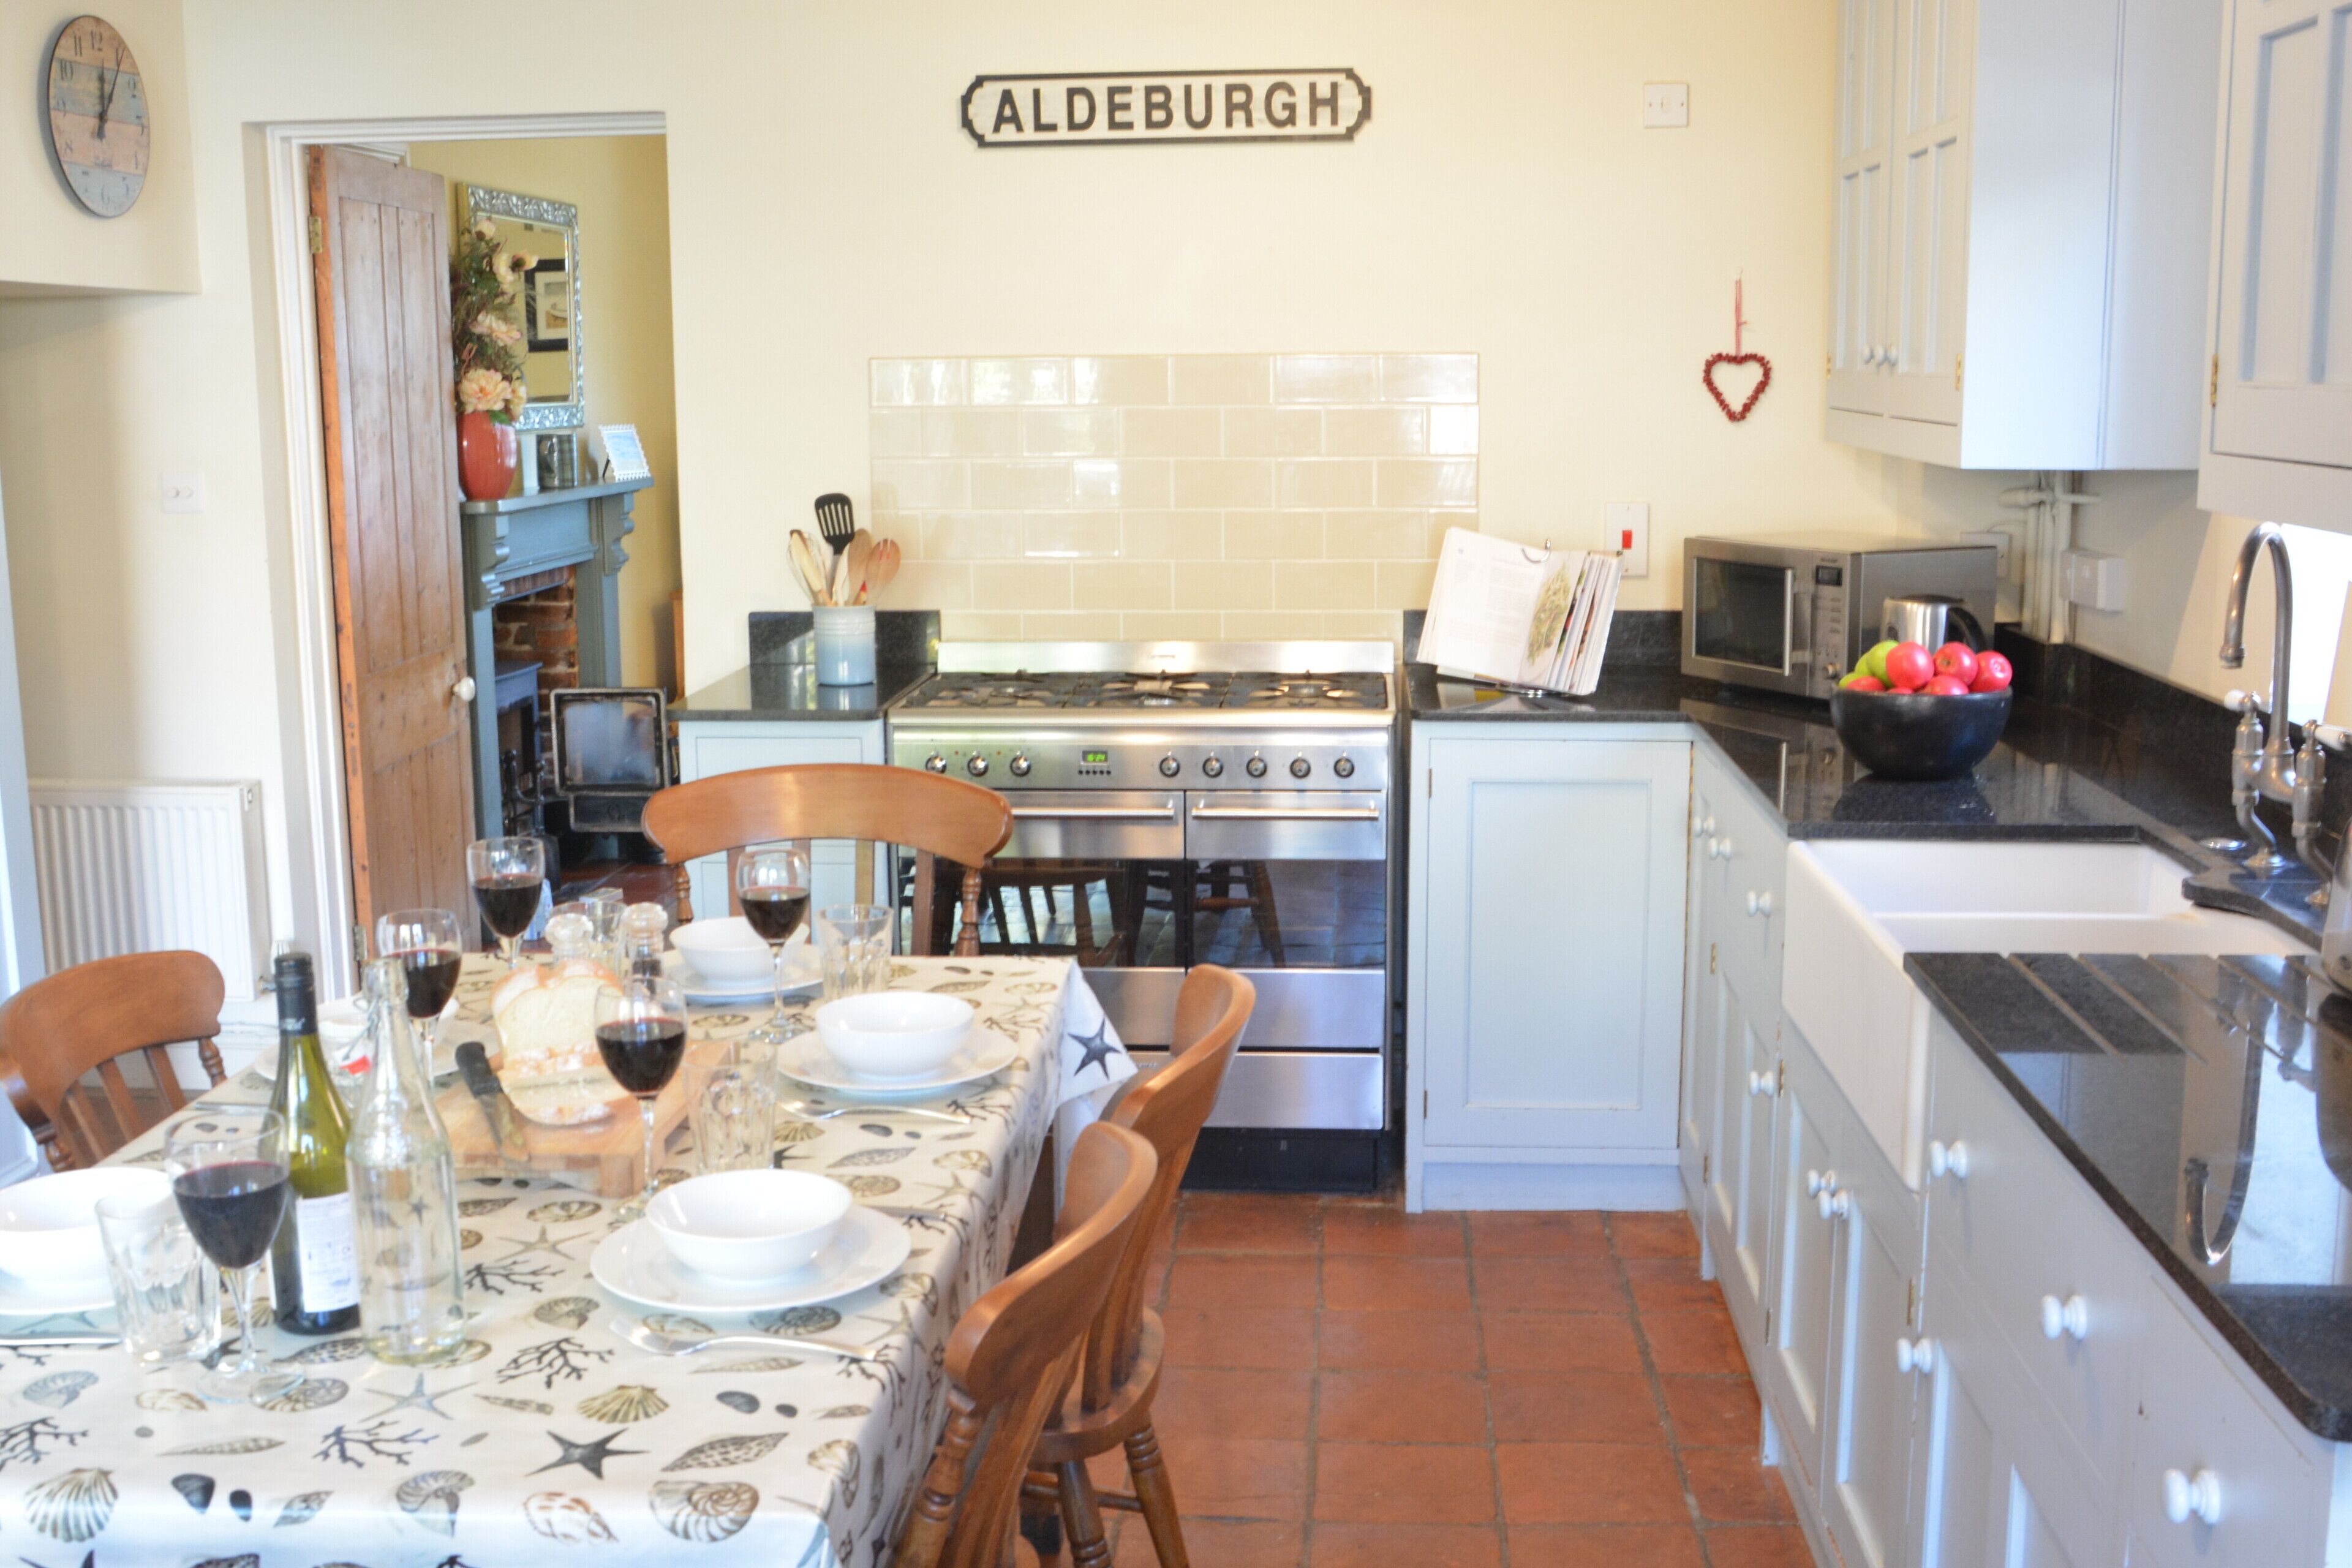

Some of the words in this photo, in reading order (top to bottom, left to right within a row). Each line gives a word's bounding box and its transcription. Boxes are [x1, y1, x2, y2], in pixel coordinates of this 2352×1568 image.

[73, 32, 83, 57] 11
[59, 59, 74, 81] 10
[992, 81, 1340, 134] ALDEBURGH
